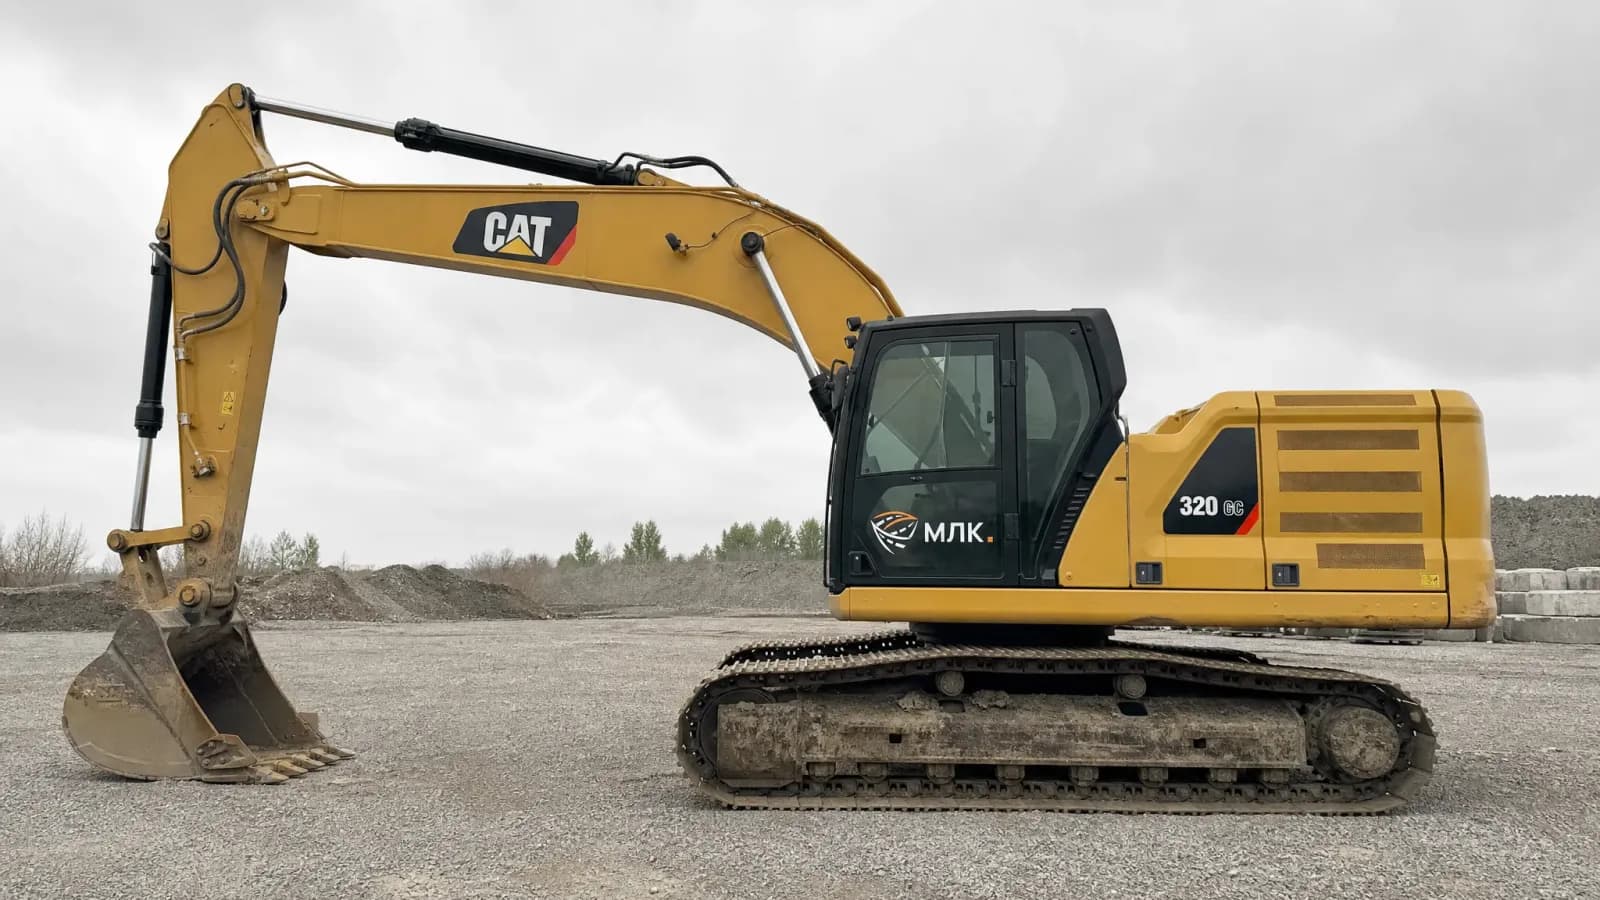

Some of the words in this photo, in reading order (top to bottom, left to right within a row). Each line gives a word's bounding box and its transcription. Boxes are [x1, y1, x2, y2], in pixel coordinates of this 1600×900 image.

[483, 211, 552, 257] CAT
[1179, 496, 1218, 516] 320
[1223, 500, 1244, 516] GC
